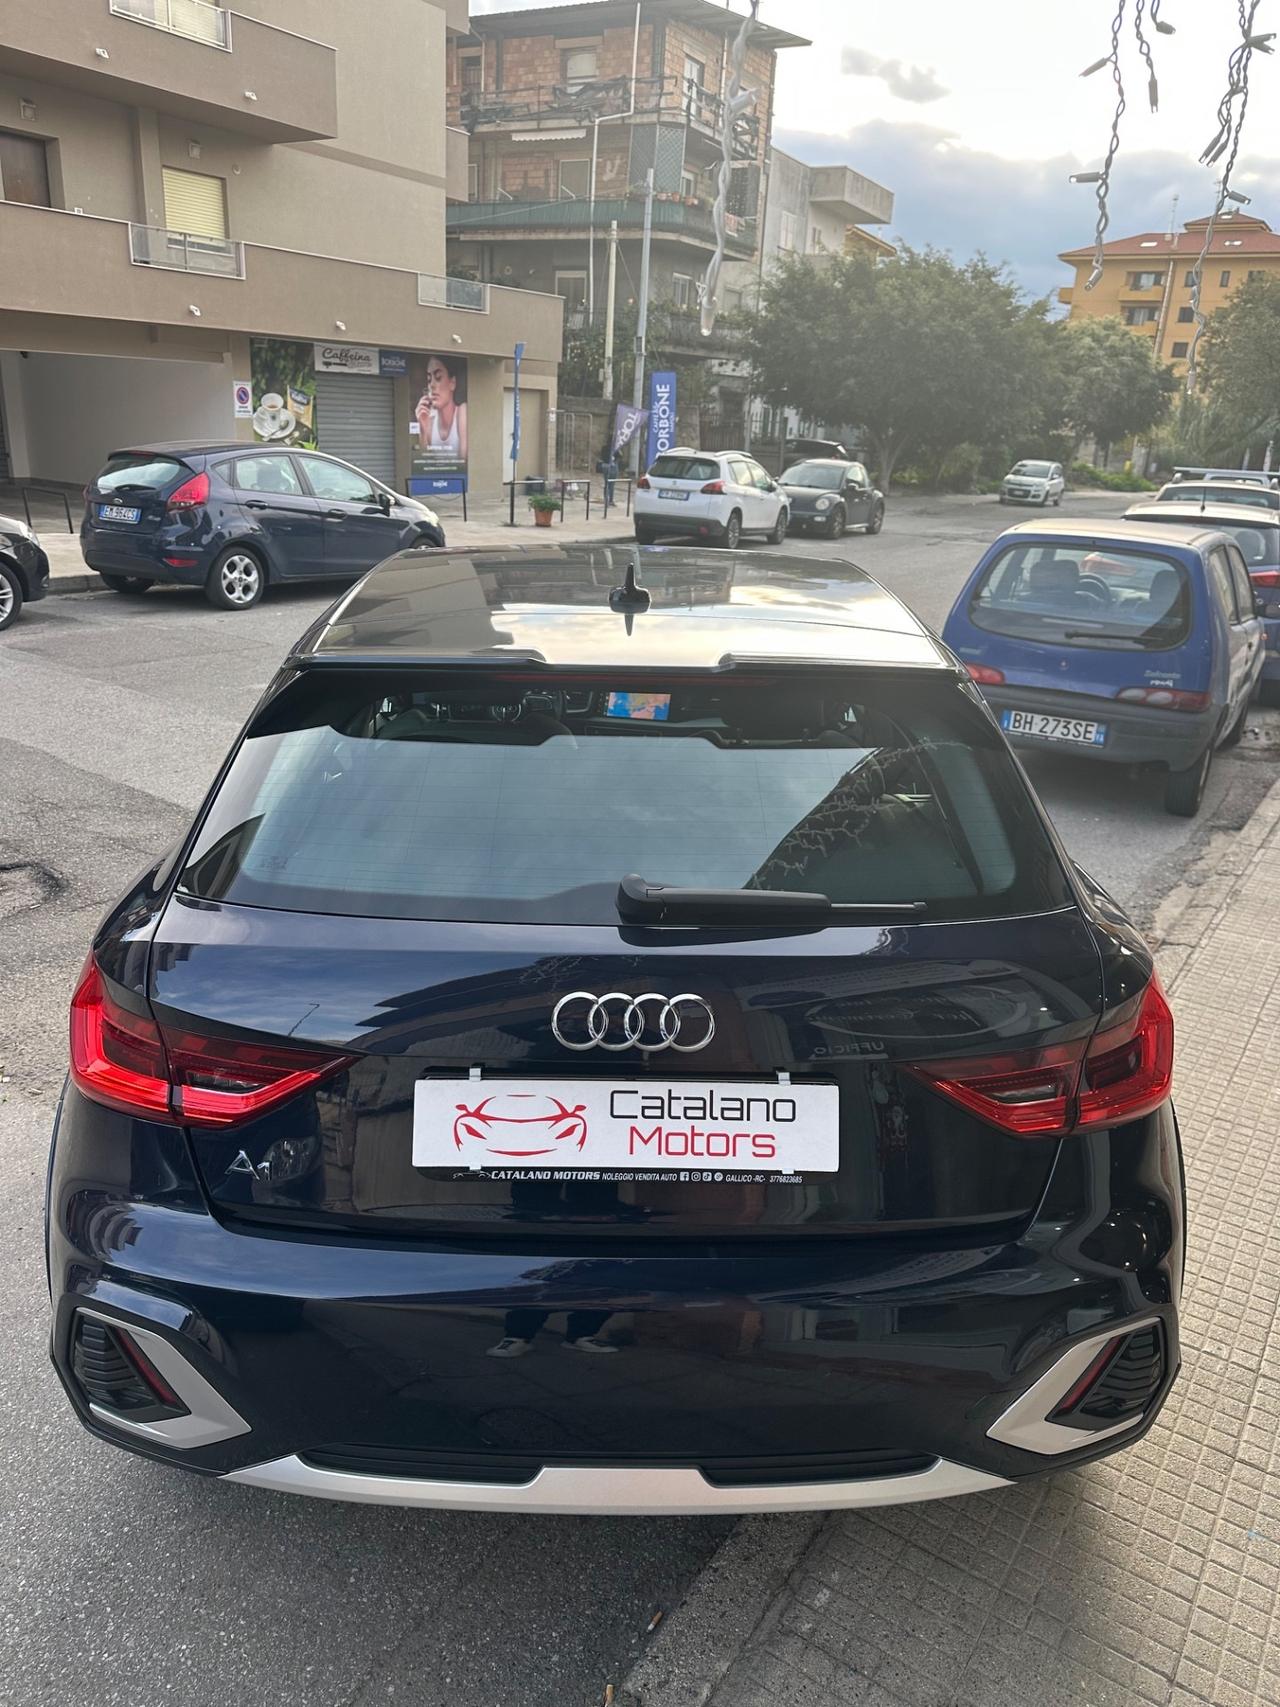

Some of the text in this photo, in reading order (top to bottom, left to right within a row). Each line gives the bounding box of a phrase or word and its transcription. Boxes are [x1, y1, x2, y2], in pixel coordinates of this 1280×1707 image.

[1012, 713, 1034, 731] BH
[1038, 717, 1096, 741] 273SE
[610, 1089, 797, 1123] Catalano
[629, 1125, 776, 1158] Motors
[224, 1149, 270, 1181] A1
[491, 1170, 551, 1180] CATALANO
[553, 1171, 600, 1180] MOTORS
[602, 1172, 634, 1181] NOLEGGIO
[635, 1173, 660, 1181] VENDITA
[660, 1173, 677, 1181] AUTO
[725, 1174, 752, 1182] GALLICO
